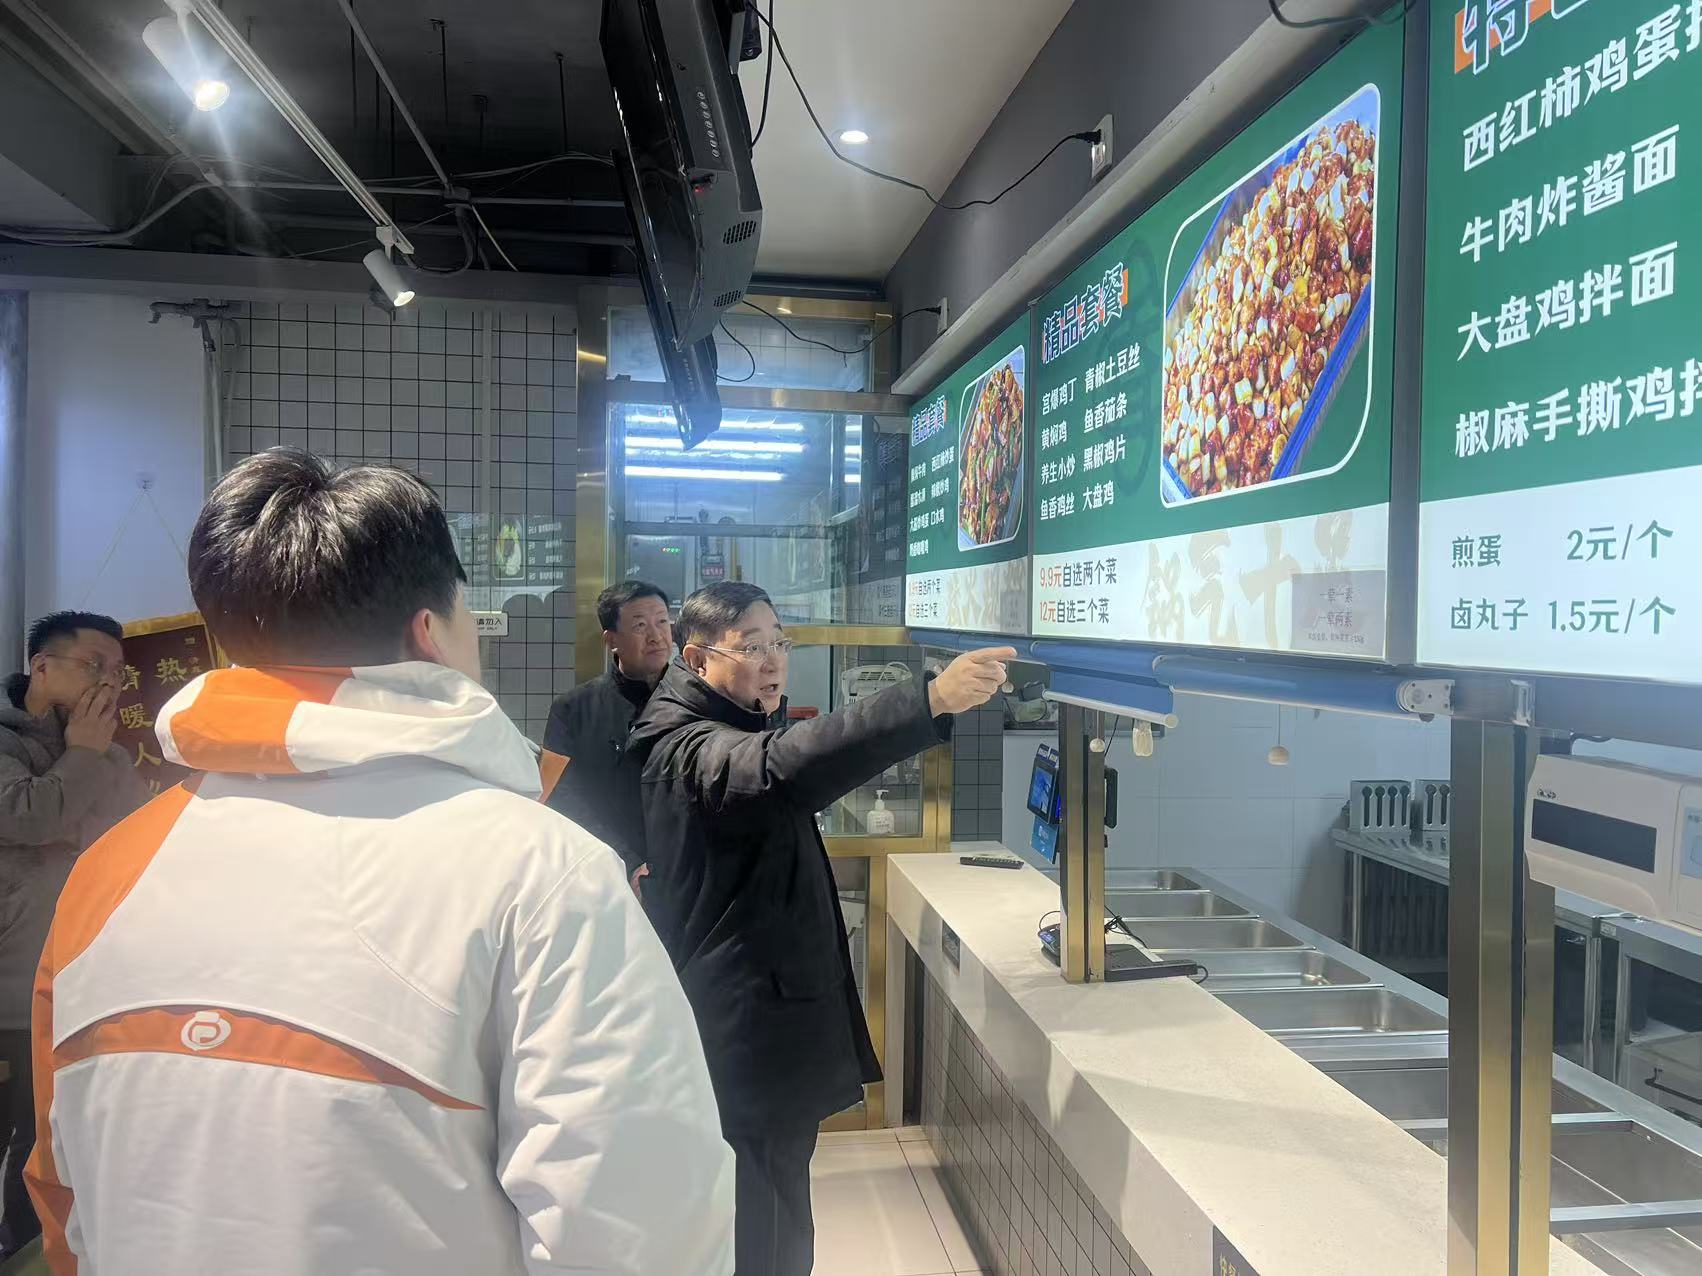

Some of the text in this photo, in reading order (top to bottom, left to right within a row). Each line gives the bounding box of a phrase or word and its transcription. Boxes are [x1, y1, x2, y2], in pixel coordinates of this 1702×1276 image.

[1460, 124, 1680, 263] 牛肉炸酱面
[1043, 261, 1124, 365] 精品套餐
[1457, 241, 1678, 362] 大盘鸡拌面
[1084, 342, 1140, 393] 青椒土豆丝
[1041, 391, 1128, 450] 黄焖鸡 鱼香茄条
[1041, 433, 1126, 485] 养生小炒 黑椒鸡片
[1040, 480, 1114, 520] 鱼香鸡丝 大盘鸡
[1452, 519, 1674, 568] 煎蛋 2元/个
[1040, 598, 1110, 623] 12元自选三个菜
[1450, 596, 1677, 635] 卤丸子 1.5元/个
